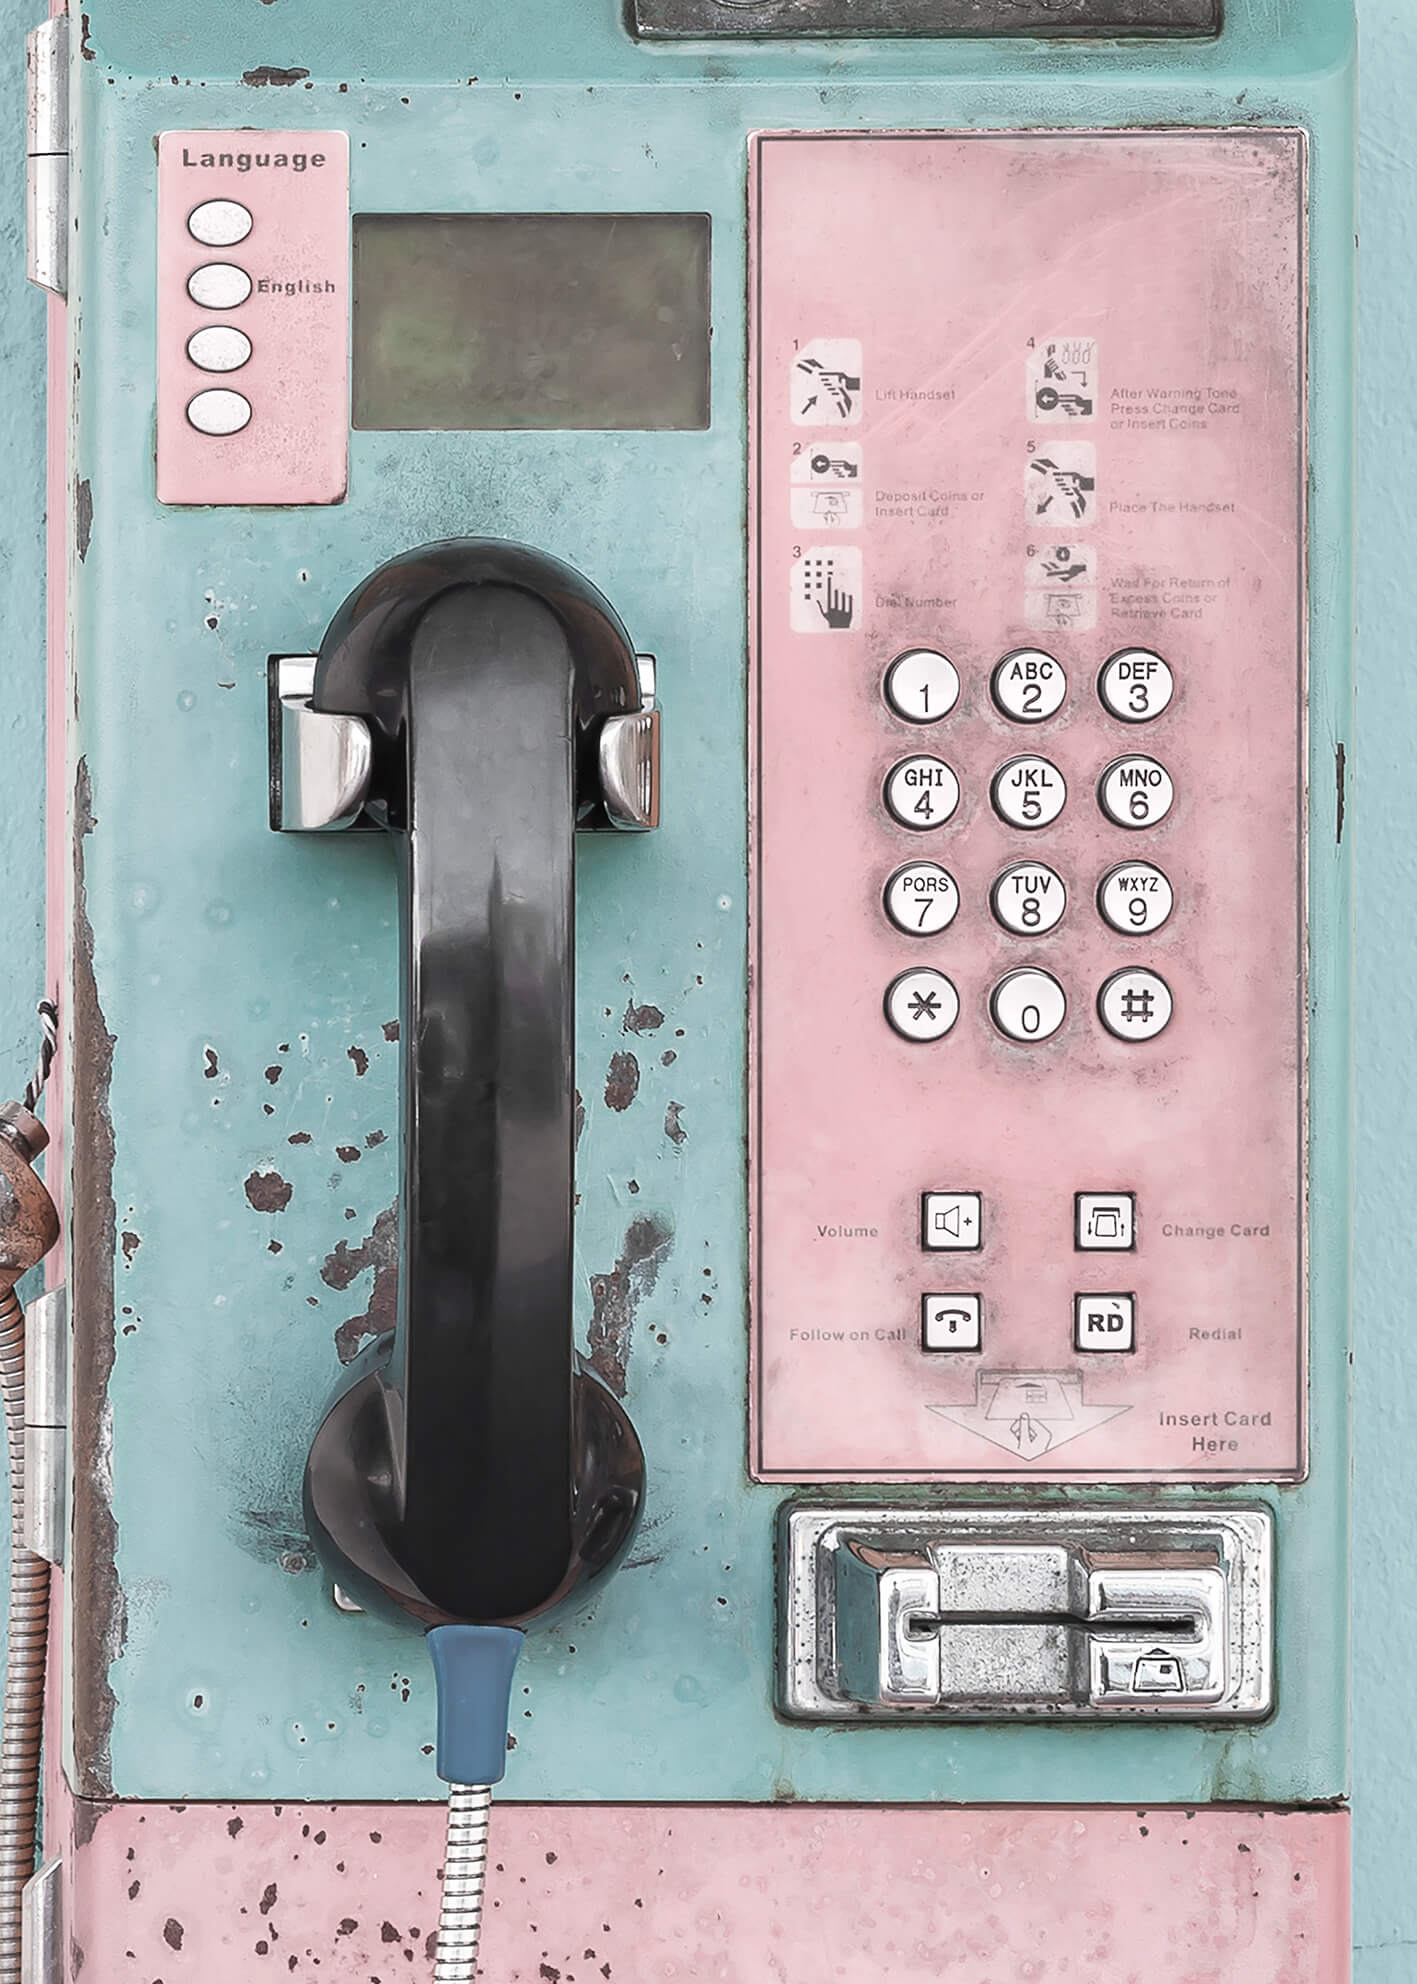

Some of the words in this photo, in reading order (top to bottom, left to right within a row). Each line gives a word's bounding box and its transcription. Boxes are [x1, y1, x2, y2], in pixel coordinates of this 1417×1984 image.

[183, 148, 326, 172] Language
[257, 280, 335, 296] English
[793, 340, 799, 350] 1
[1026, 338, 1036, 349] 4
[875, 389, 896, 401] Lift
[900, 389, 956, 401] Handset
[1110, 388, 1144, 400] After
[1147, 388, 1200, 402] Warning
[1206, 388, 1237, 400] Tone
[1110, 403, 1148, 415] Press
[1152, 403, 1204, 417] Change
[1208, 403, 1240, 415] Card
[1110, 421, 1124, 430] or
[1127, 419, 1166, 430] Insert
[1169, 419, 1208, 430] Coins
[792, 443, 802, 455] 2
[1027, 441, 1036, 453] 5
[875, 490, 926, 503] Deposit
[929, 490, 967, 502] Coins
[971, 492, 985, 502] or
[875, 506, 914, 517] Insert
[917, 506, 949, 517] Card
[1109, 502, 1147, 513] Place
[1151, 502, 1175, 513] The
[1179, 502, 1235, 513] Handset
[792, 546, 802, 558] 3
[1026, 545, 1035, 557] 6
[1143, 578, 1166, 588] For
[1169, 577, 1215, 588] Return
[1217, 577, 1231, 588] of
[905, 597, 957, 608] Number
[1162, 593, 1200, 604] Coins
[1170, 608, 1202, 619] Card
[1010, 662, 1053, 680] ABC
[1118, 662, 1159, 680] DEF
[919, 684, 930, 713] 1
[1022, 683, 1043, 713] 2
[1128, 683, 1149, 713] 3
[904, 769, 944, 787] GHI
[1011, 769, 1054, 787] JKL
[1120, 769, 1162, 787] MNO
[914, 790, 934, 820] 4
[1022, 790, 1042, 820] 5
[1129, 790, 1149, 820] 6
[903, 877, 949, 893] PQRS
[1011, 876, 1051, 894] TUV
[1118, 877, 1159, 893] WXYZ
[914, 898, 934, 927] 7
[1022, 897, 1041, 927] 8
[1128, 897, 1147, 926] 9
[1121, 989, 1154, 1022] #
[1021, 1005, 1041, 1034] 0
[817, 1225, 878, 1238] Volume
[1162, 1224, 1226, 1240] Change
[1230, 1224, 1270, 1237] Card
[1087, 1314, 1124, 1333] RD
[790, 1329, 845, 1341] Follow
[850, 1331, 870, 1341] on
[875, 1329, 906, 1341] Call
[1189, 1327, 1242, 1340] Redial
[1159, 1412, 1218, 1426] Insert
[1224, 1411, 1272, 1426] Card
[1192, 1436, 1239, 1451] Here
